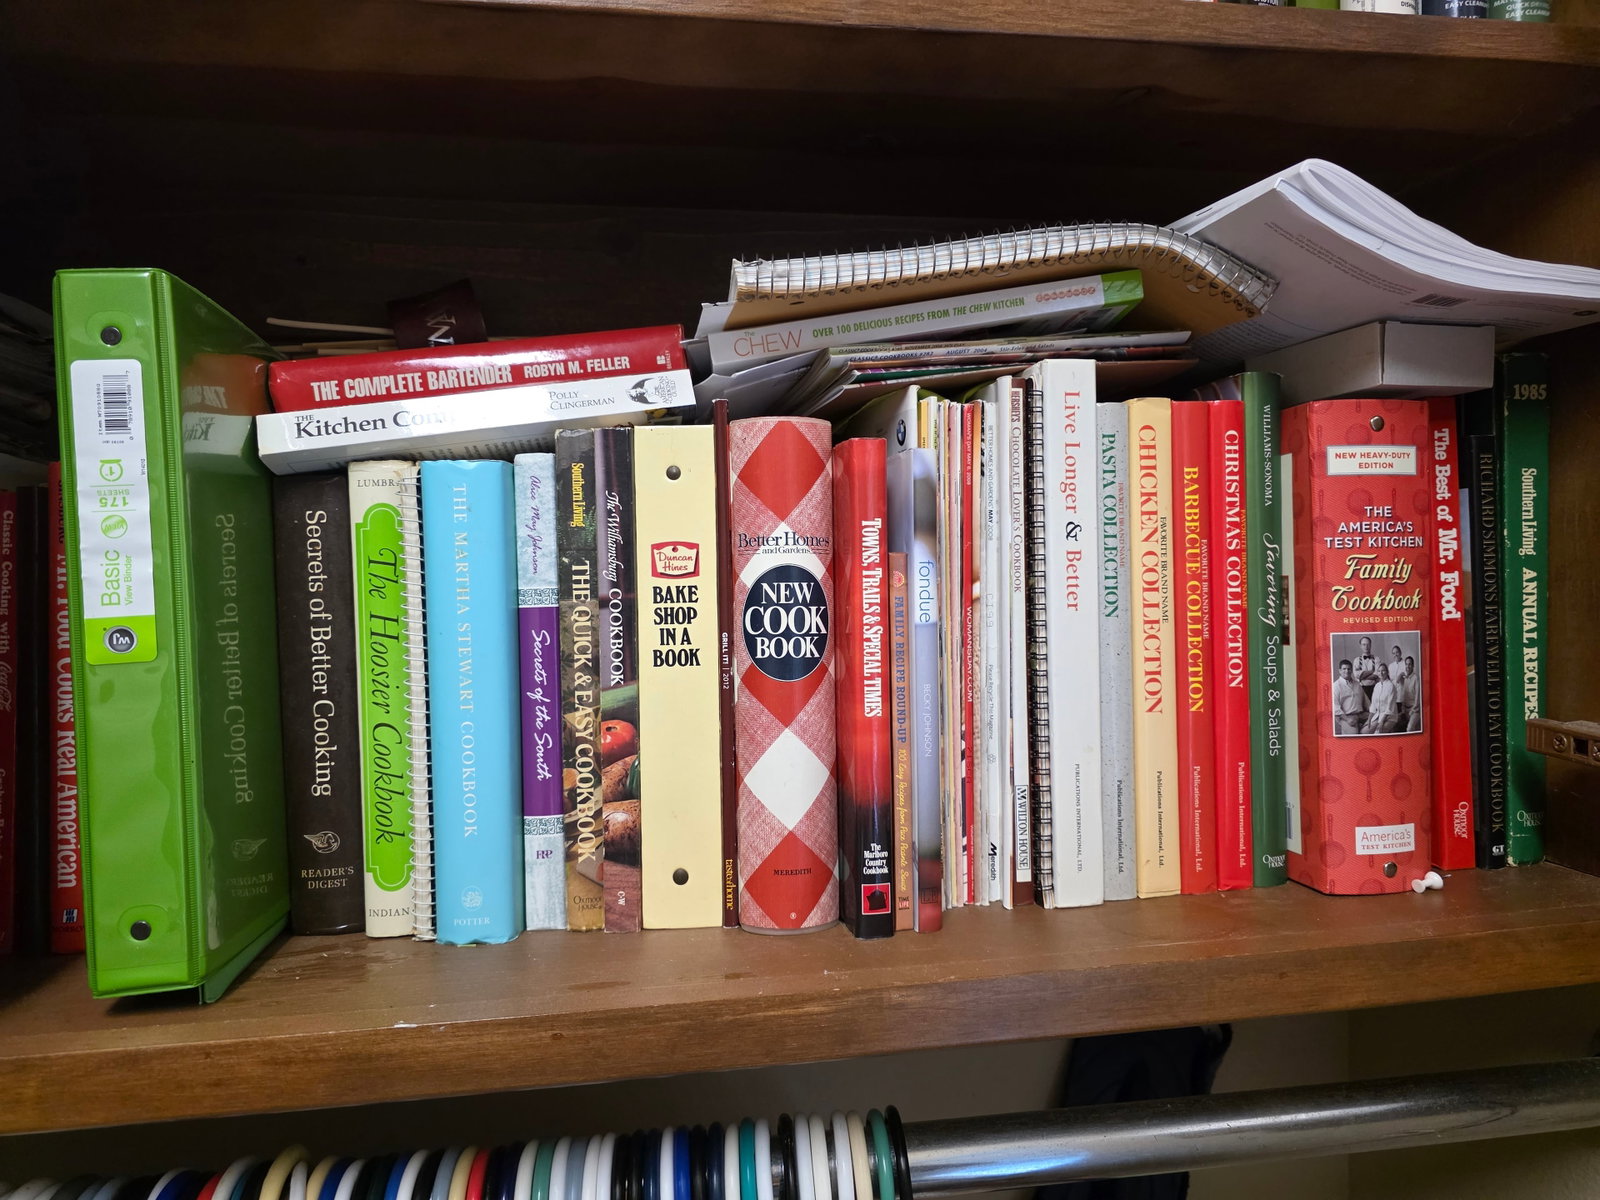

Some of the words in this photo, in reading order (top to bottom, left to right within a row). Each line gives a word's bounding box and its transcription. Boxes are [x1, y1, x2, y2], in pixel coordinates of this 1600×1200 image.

[812, 327, 834, 338] OVER
[836, 325, 852, 335] 100
[853, 318, 894, 332] DELICIOUS
[895, 313, 925, 325] RECIPES
[927, 309, 950, 321] FROM
[953, 306, 967, 317] THE
[969, 302, 991, 315] CHEW
[993, 297, 1025, 310] KITCHEN
[733, 329, 803, 358] CHEW
[311, 381, 341, 402] THE
[343, 373, 424, 399] COMPLETE
[427, 364, 513, 391] BARTENDER
[523, 363, 565, 379] ROBYN
[568, 361, 584, 375] M.
[586, 356, 631, 373] FELLER
[550, 391, 579, 401] POLLY
[550, 397, 615, 411] CLINGERMAN
[1010, 390, 1021, 423] HERSHEY'S
[1513, 383, 1548, 400] 1985
[294, 416, 387, 439] Kitchen
[295, 414, 314, 422] THE
[1064, 390, 1081, 434] Live
[1011, 427, 1022, 489] CHOCOLATE
[1101, 433, 1118, 490] PASTA
[1263, 404, 1273, 507] WILLIAMS-SONOMA
[1335, 452, 1357, 460] NEW
[1360, 452, 1411, 460] HEAVY-DUTY
[1433, 428, 1449, 460] The
[571, 463, 586, 501] Southern
[1059, 441, 1081, 514] Longer
[1358, 462, 1394, 470] EDITION
[1435, 464, 1451, 500] Best
[99, 496, 129, 507] 175
[529, 475, 541, 501] Alice
[605, 490, 623, 511] The
[1117, 481, 1125, 515] FAVORITE
[1138, 424, 1159, 544] CHICKEN
[1224, 429, 1241, 550] CHRISTMAS
[1480, 453, 1495, 528] RICHARD
[1521, 468, 1537, 520] Southern
[451, 484, 469, 524] THE
[525, 505, 541, 532] May
[570, 501, 586, 527] Living
[1012, 491, 1023, 532] LOVER'S
[1183, 466, 1201, 574] BARBECUE
[1364, 506, 1393, 518] THE
[1437, 505, 1453, 523] of
[738, 533, 783, 548] Better
[784, 531, 830, 547] Homes
[860, 517, 882, 567] TOWNS,
[1065, 521, 1083, 542] &
[1160, 516, 1168, 557] FAVORITE
[1324, 536, 1362, 549] TEST
[1368, 536, 1423, 548] KITCHEN
[1337, 521, 1413, 534] AMERICA'S
[1518, 521, 1538, 556] Living
[526, 535, 543, 575] Johnson
[603, 513, 624, 582] Williamsburg
[656, 551, 694, 562] Duncan
[761, 546, 778, 554] and
[778, 546, 811, 554] Gardens
[1013, 535, 1023, 592] COOKBOOK
[1102, 494, 1120, 619] COLLECTION
[1438, 528, 1457, 565] Mr.
[100, 549, 121, 606] Basic
[123, 554, 133, 583] Binder
[367, 548, 399, 600] The
[454, 532, 471, 616] MARTHA
[571, 560, 591, 603] THE
[662, 561, 688, 572] Hines
[1065, 550, 1083, 612] Better
[1161, 560, 1169, 594] BRAND
[1257, 533, 1280, 628] Savoring
[1344, 554, 1413, 584] Family
[1482, 531, 1498, 601] SIMMONS
[124, 584, 134, 606] View
[652, 585, 699, 604] BAKE
[761, 582, 815, 604] NEW
[861, 567, 882, 614] TRAILS
[918, 560, 935, 624] fondue
[1331, 585, 1424, 612] Cookbook
[1439, 570, 1462, 621] Food
[1522, 567, 1538, 644] ANNUAL
[653, 606, 698, 626] SHOP
[745, 605, 828, 635] COOK
[862, 614, 882, 625] &
[894, 596, 905, 639] FAMILY
[1161, 595, 1170, 624] NAME
[1226, 556, 1244, 689] COLLECTION
[1343, 616, 1381, 624] REVISED
[1383, 615, 1414, 623] EDITION
[571, 605, 592, 669] QUICK
[608, 588, 624, 687] COOKBOOK
[659, 627, 677, 646] IN
[680, 626, 692, 646] A
[755, 636, 821, 659] BOOK
[1140, 550, 1163, 714] COLLECTION
[1185, 580, 1204, 713] COLLECTION
[1484, 605, 1500, 688] FAREWELL
[369, 610, 402, 714] Hoosier
[458, 622, 475, 713] STEWART
[531, 630, 552, 684] Secrets
[652, 648, 701, 668] BOOK
[862, 625, 884, 677] SPECIAL
[895, 642, 906, 683] RECIPE
[1263, 635, 1280, 684] Soups
[526, 688, 551, 703] of
[574, 672, 593, 687] &
[722, 673, 730, 690] 2012
[923, 683, 931, 710] BECKY
[1267, 689, 1280, 702] &
[1523, 646, 1539, 721] RECIPES
[574, 690, 593, 740] EASY
[863, 677, 882, 718] TIMES
[897, 685, 907, 744] ROUND-UP
[1488, 689, 1501, 710] TO
[535, 705, 552, 732] the
[924, 713, 933, 757] JOHNSON
[1267, 708, 1282, 757] Salads
[1488, 713, 1502, 739] FAT
[535, 736, 553, 782] South
[370, 722, 406, 846] Cookbook
[461, 720, 478, 839] COOKBOOK
[1490, 743, 1504, 832] COOKBOOK
[575, 743, 596, 863] COOKBOOK
[1018, 800, 1028, 836] WILTON
[870, 843, 882, 852] The
[1018, 838, 1029, 868] HOUSE
[1361, 829, 1412, 843] America's
[301, 867, 355, 876] READER'S
[773, 868, 812, 876] MEREDITH
[863, 850, 889, 859] Marlboro
[863, 866, 889, 875] Cookbook
[865, 858, 887, 867] Country
[988, 841, 998, 881] Meredith
[308, 879, 348, 888] DIGEST
[454, 917, 491, 926] POTTER
